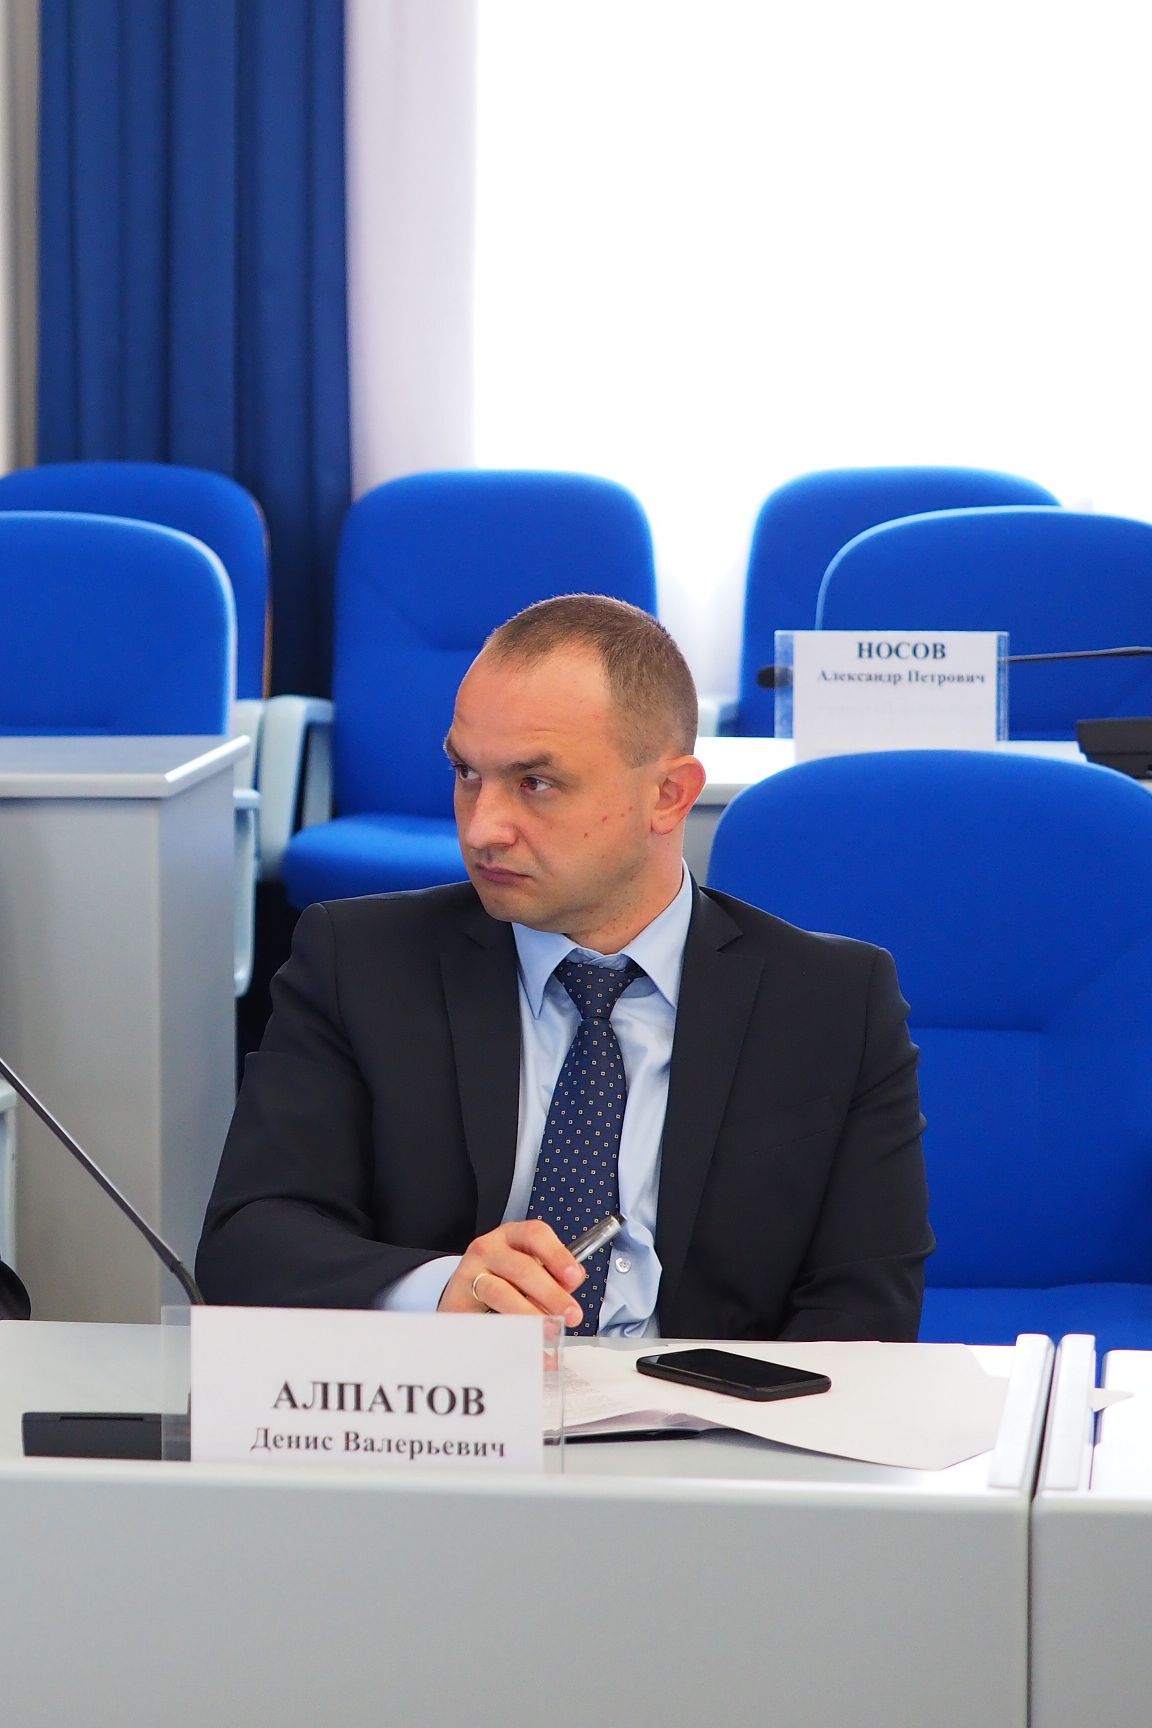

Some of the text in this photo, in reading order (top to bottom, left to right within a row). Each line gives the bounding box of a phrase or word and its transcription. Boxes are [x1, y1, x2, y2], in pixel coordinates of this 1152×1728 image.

[857, 642, 947, 660] НОСОВ
[818, 670, 986, 686] Александр Петрович
[272, 1381, 486, 1416] АЛПАТОВ
[251, 1427, 506, 1460] Денис Валерьевич
